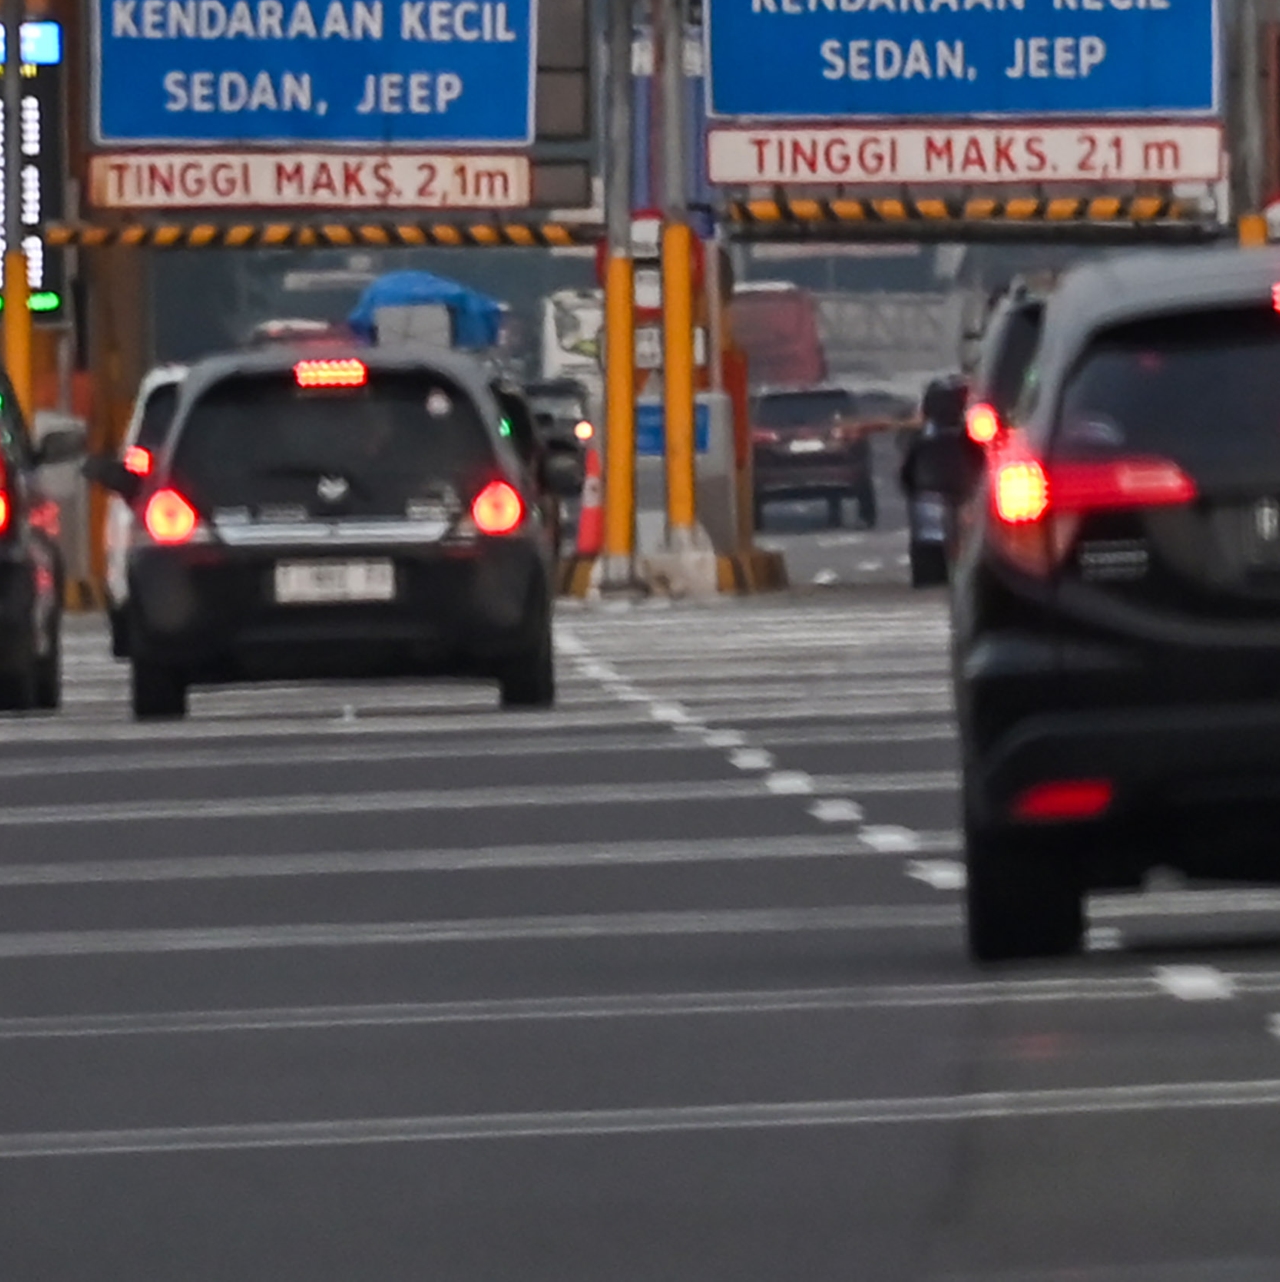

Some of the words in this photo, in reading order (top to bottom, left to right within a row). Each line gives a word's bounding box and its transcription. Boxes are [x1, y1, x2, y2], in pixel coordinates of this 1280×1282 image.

[400, 1, 516, 42] KECIL
[820, 39, 978, 82] SEDAN,
[1004, 35, 1106, 79] JEEP
[163, 70, 328, 116] SEDAN,
[356, 73, 463, 115] JEEP
[750, 138, 898, 176] TINGGI
[108, 161, 251, 199] TINGGI
